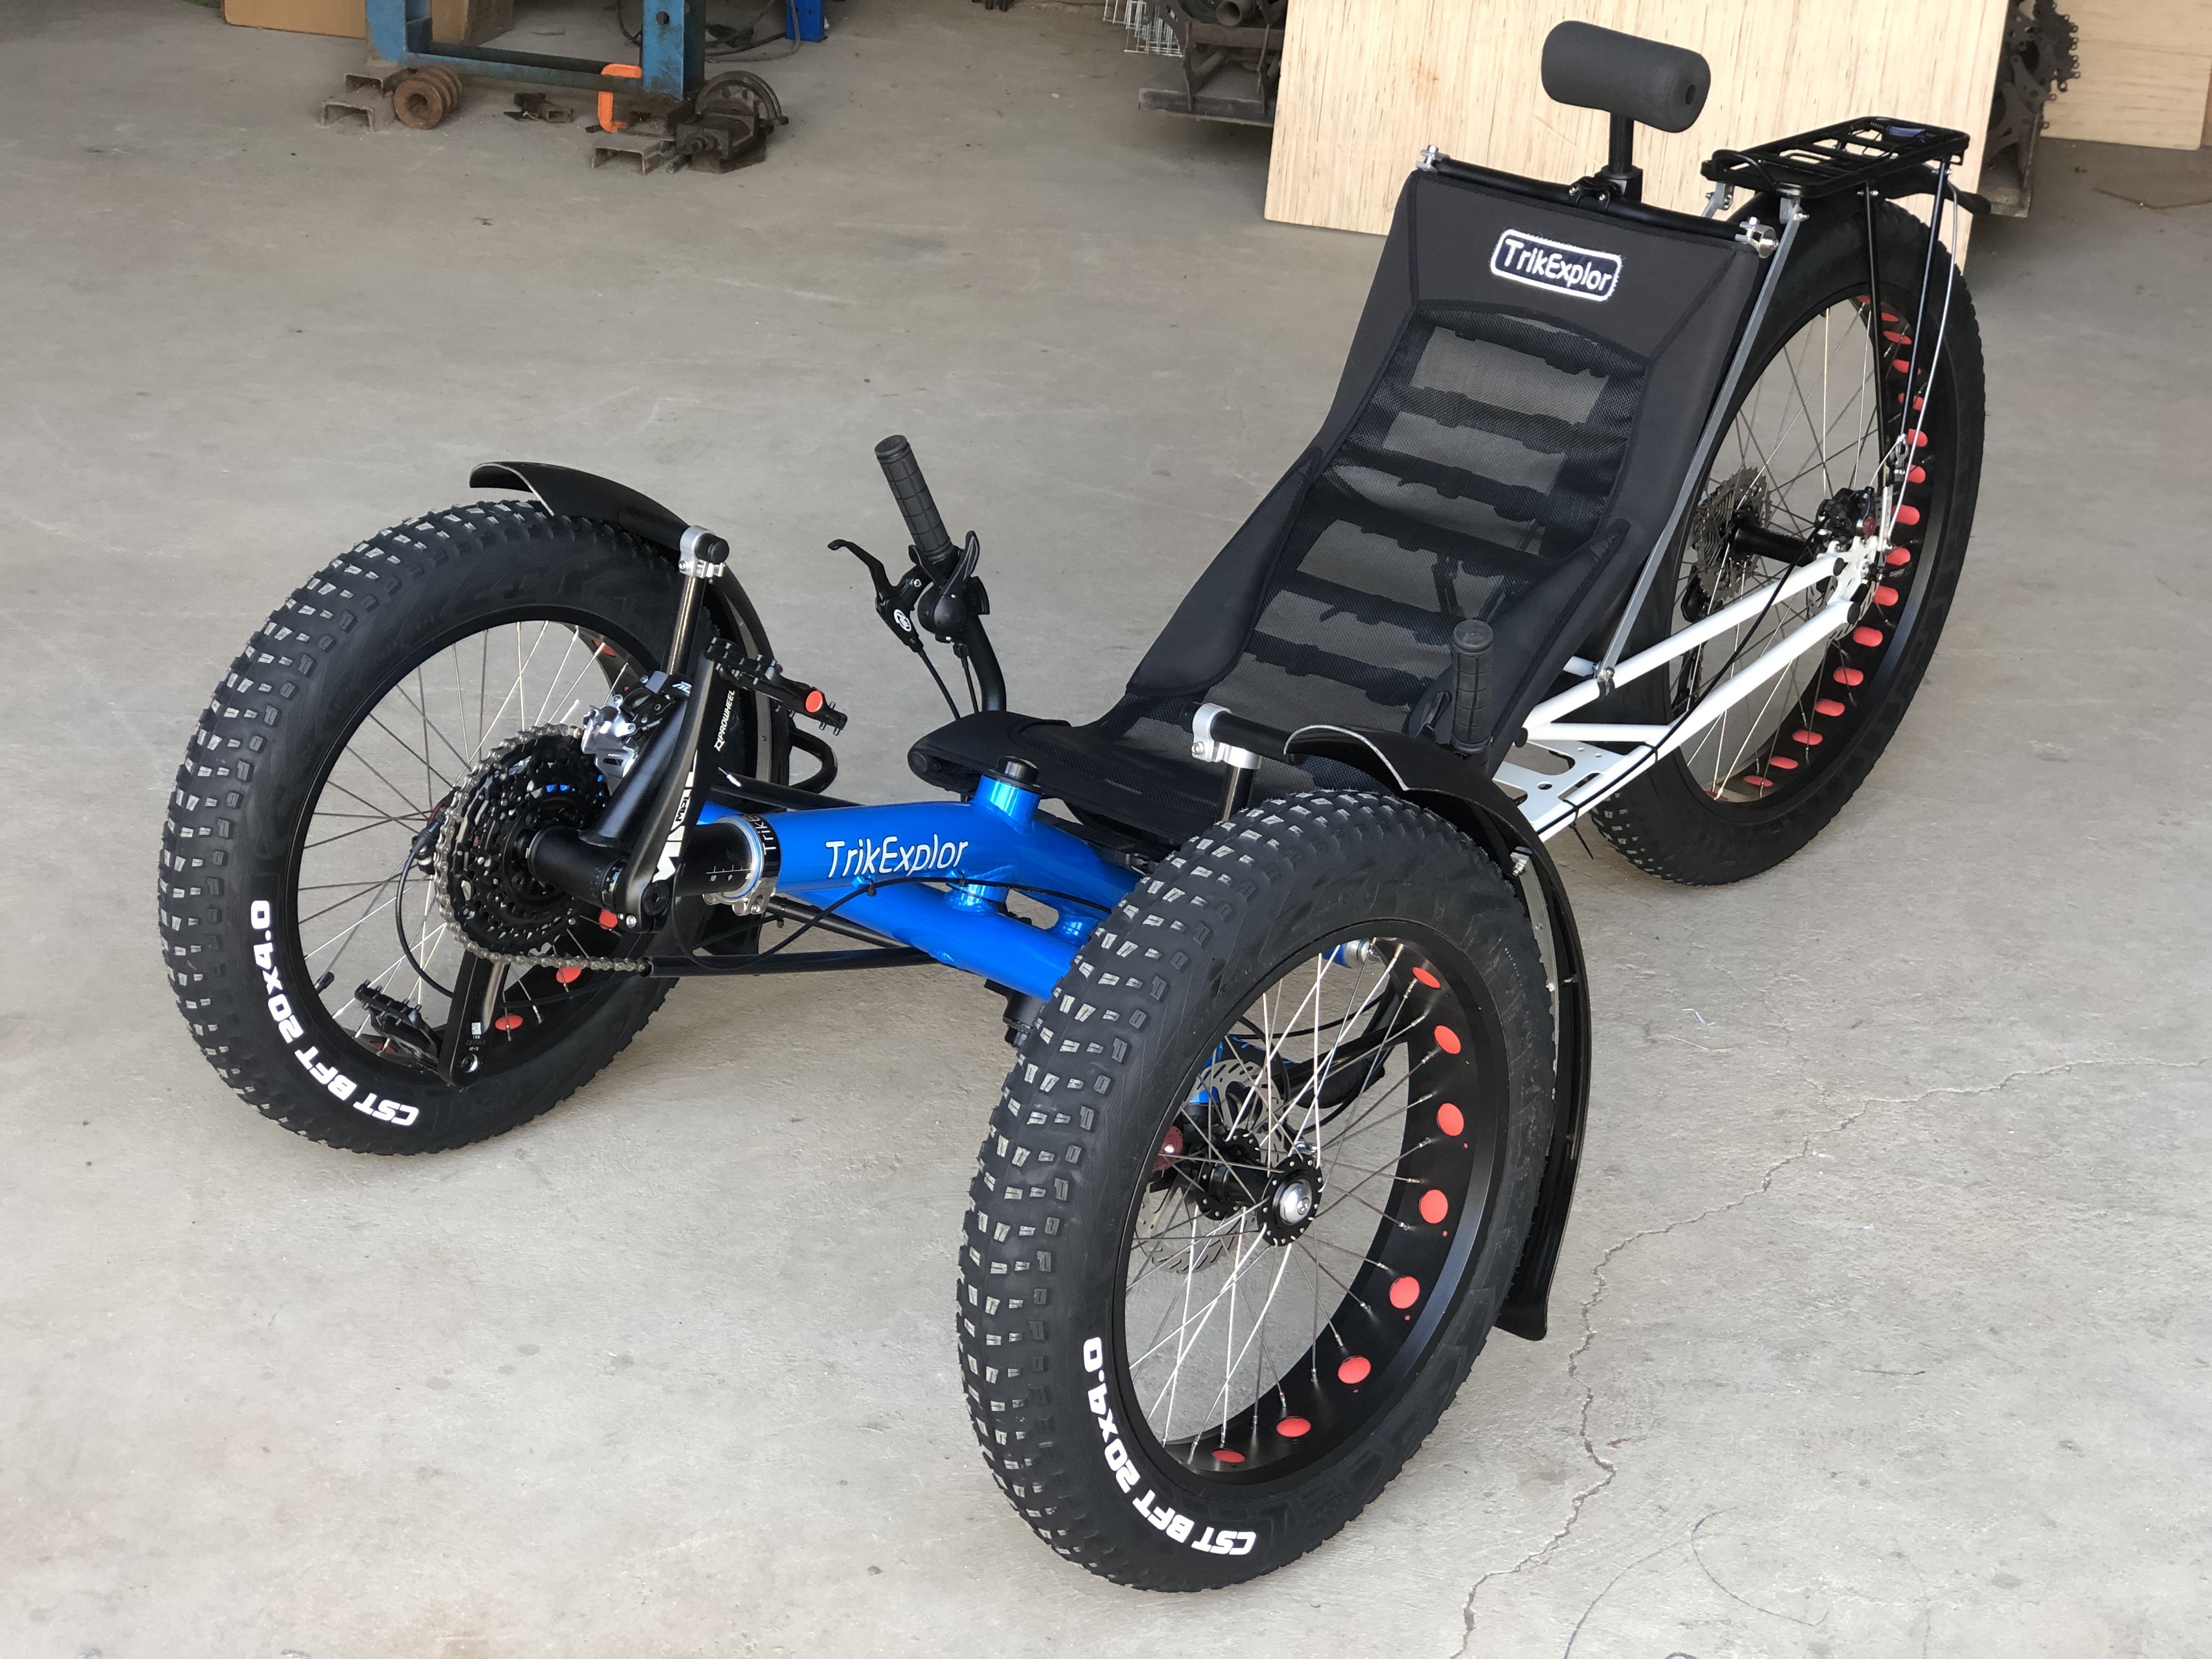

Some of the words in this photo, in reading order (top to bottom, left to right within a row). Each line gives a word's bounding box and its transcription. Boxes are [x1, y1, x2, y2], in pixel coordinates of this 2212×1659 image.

[1504, 238, 1612, 292] TrikExplor
[718, 690, 735, 741] PROWHEEL
[825, 833, 969, 878] TrikExplor
[295, 1046, 357, 1101] BFT
[353, 1093, 419, 1126] CST
[1132, 1489, 1194, 1543] BFT
[1191, 1527, 1256, 1555] CST
